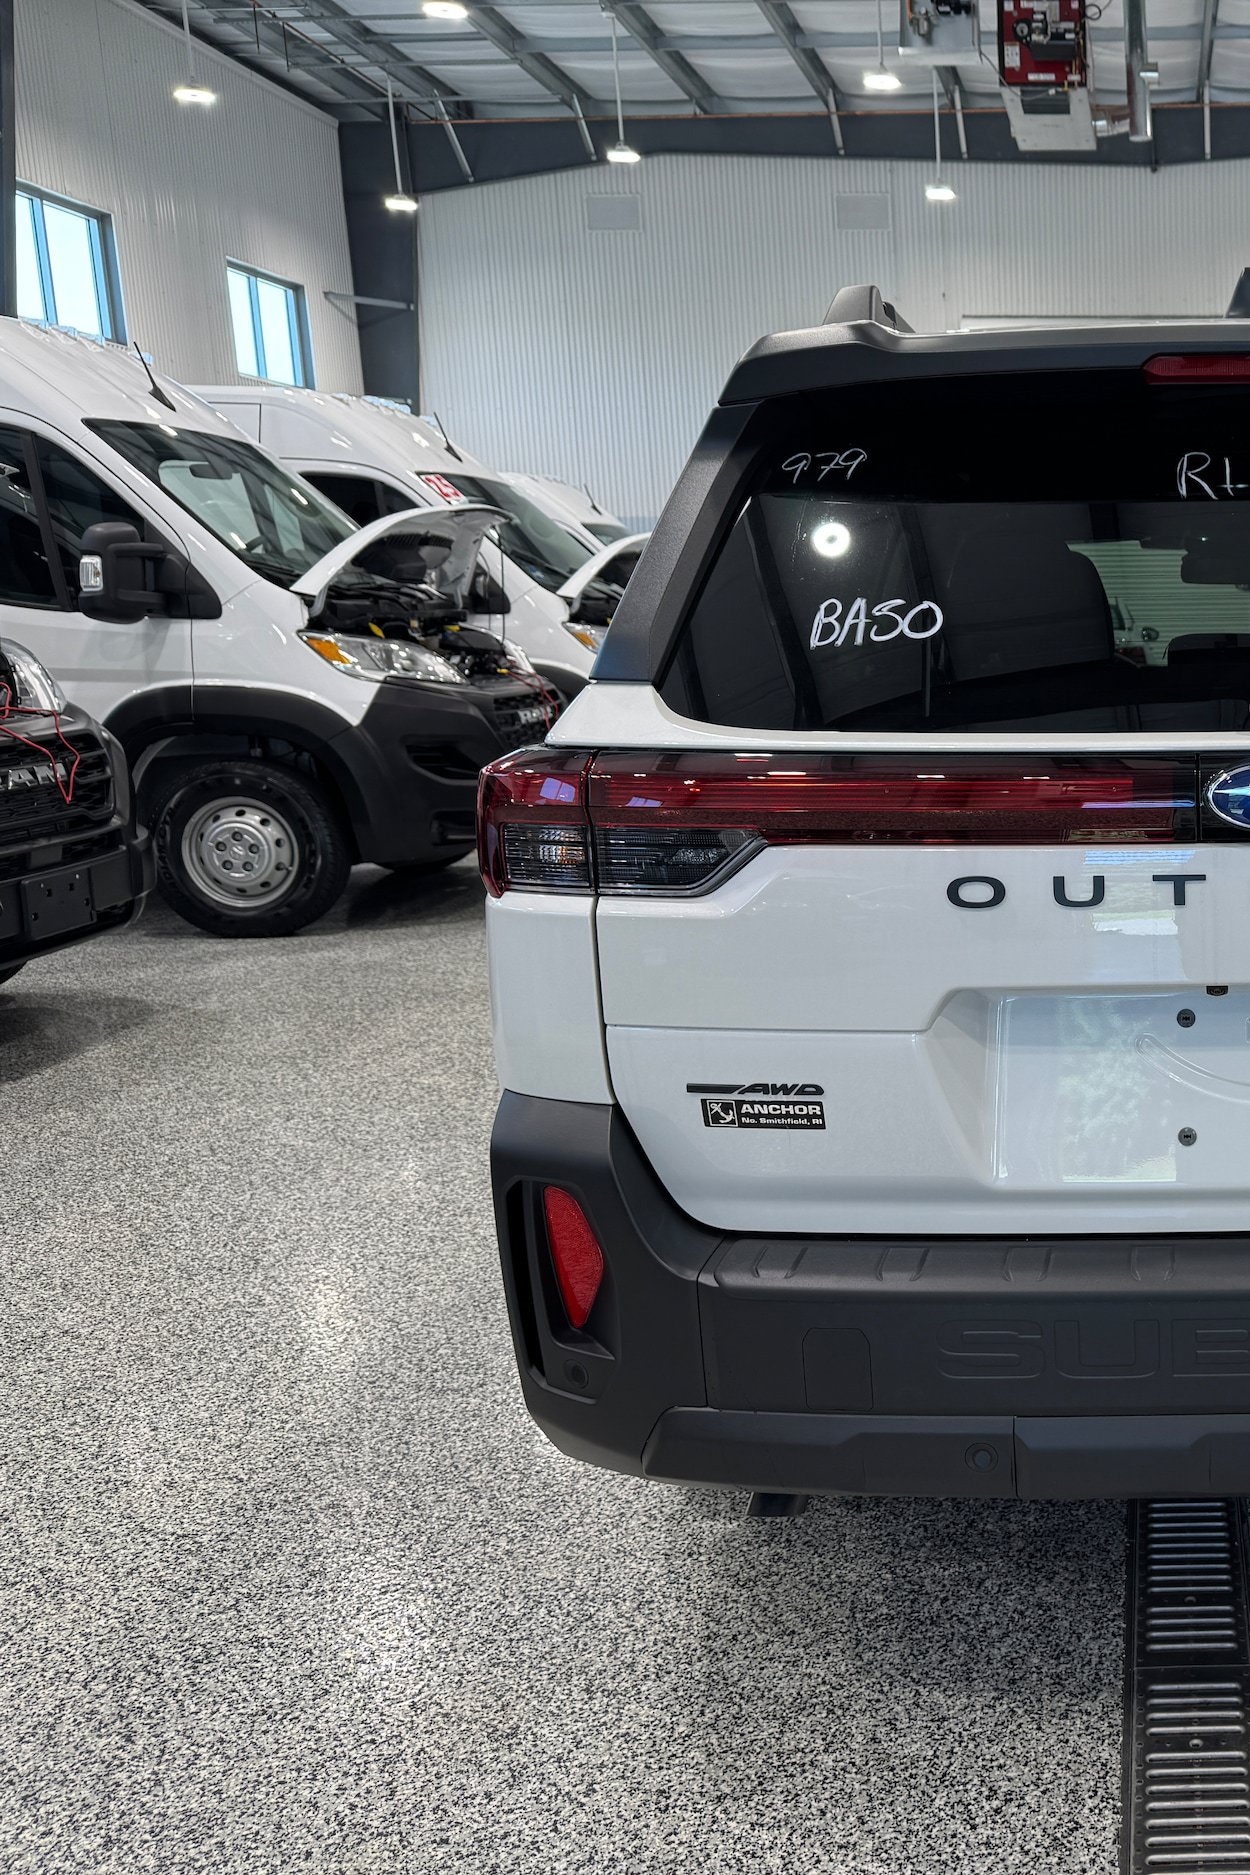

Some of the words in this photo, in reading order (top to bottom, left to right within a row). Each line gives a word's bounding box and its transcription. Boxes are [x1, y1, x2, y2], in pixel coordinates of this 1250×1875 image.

[782, 448, 867, 484] 979
[0, 763, 68, 790] AM
[737, 1083, 825, 1096] AWD
[740, 1103, 822, 1115] ANCHOR
[759, 1117, 811, 1126] Smithfield,
